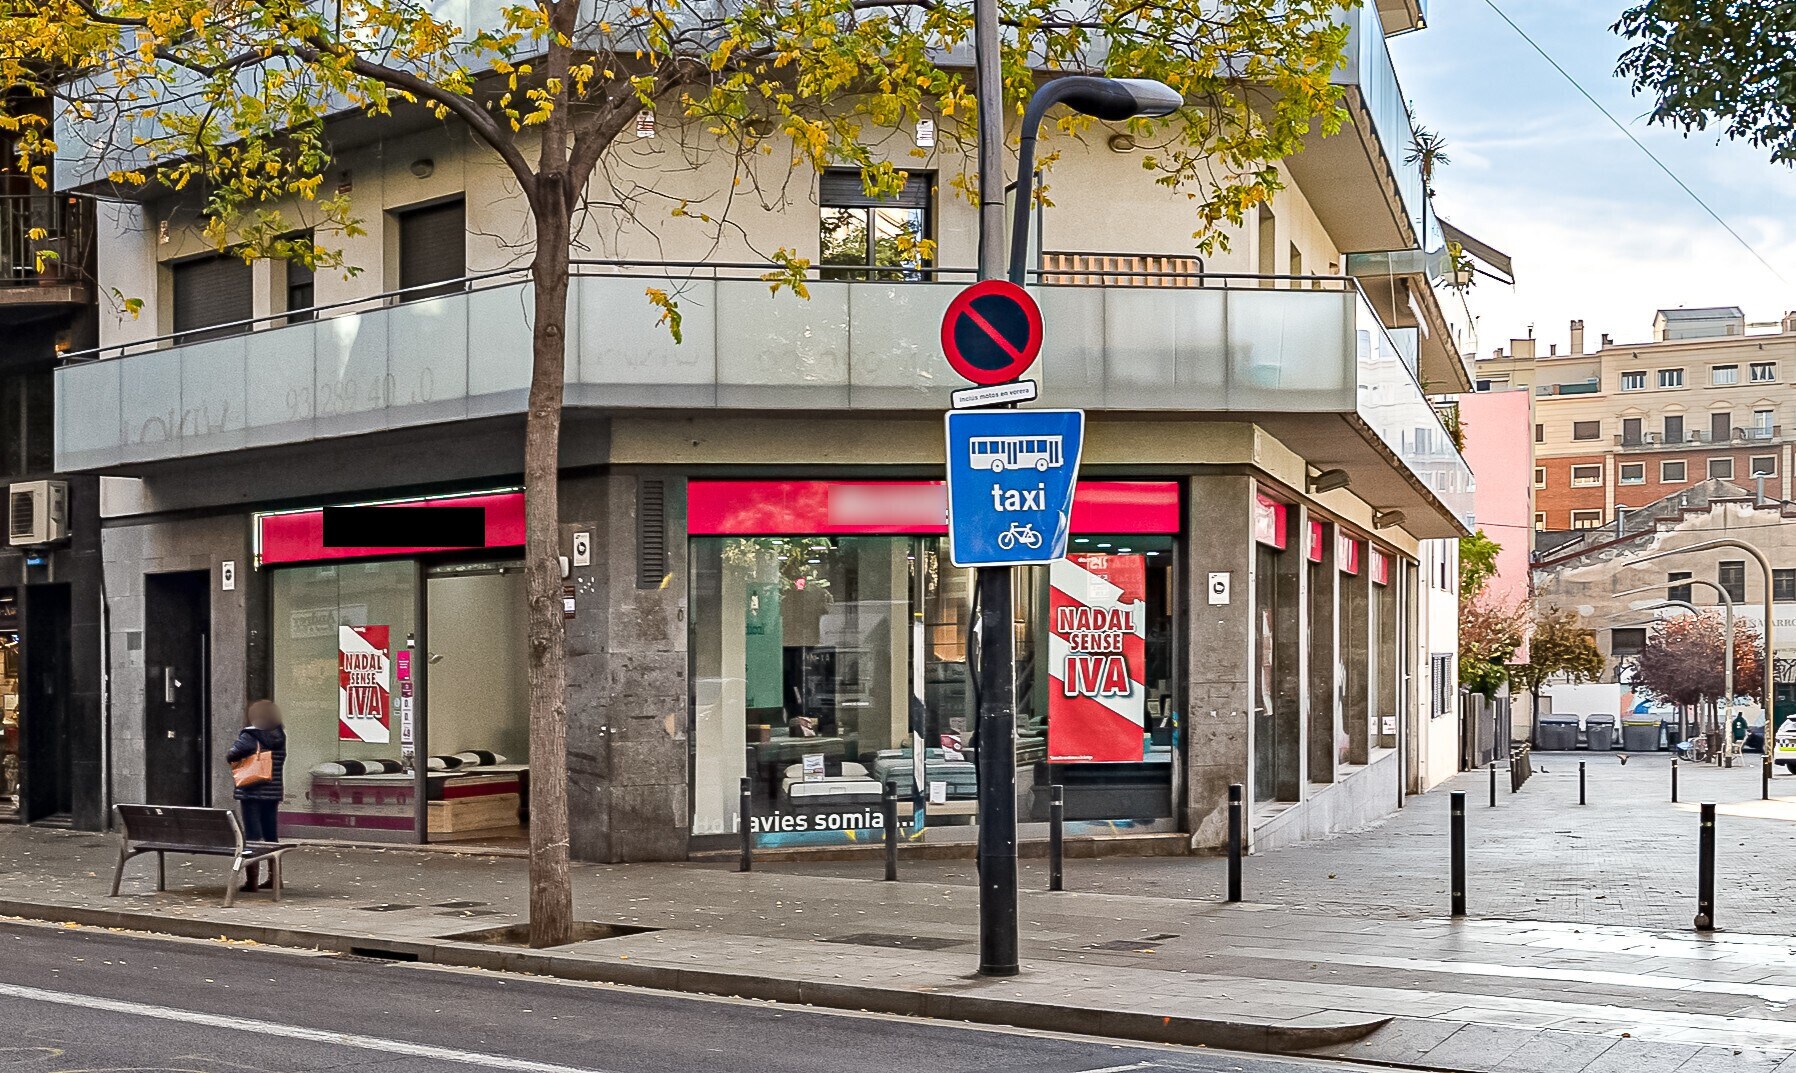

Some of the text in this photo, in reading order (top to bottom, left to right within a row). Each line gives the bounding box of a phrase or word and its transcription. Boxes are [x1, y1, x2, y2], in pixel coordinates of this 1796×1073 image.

[991, 482, 1046, 512] taxi
[1057, 607, 1135, 632] NADAL
[1069, 633, 1124, 652] SENSE
[344, 652, 383, 672] NADAL
[350, 672, 377, 685] SENSE
[1065, 655, 1130, 696] IVA
[347, 685, 383, 718] IVA
